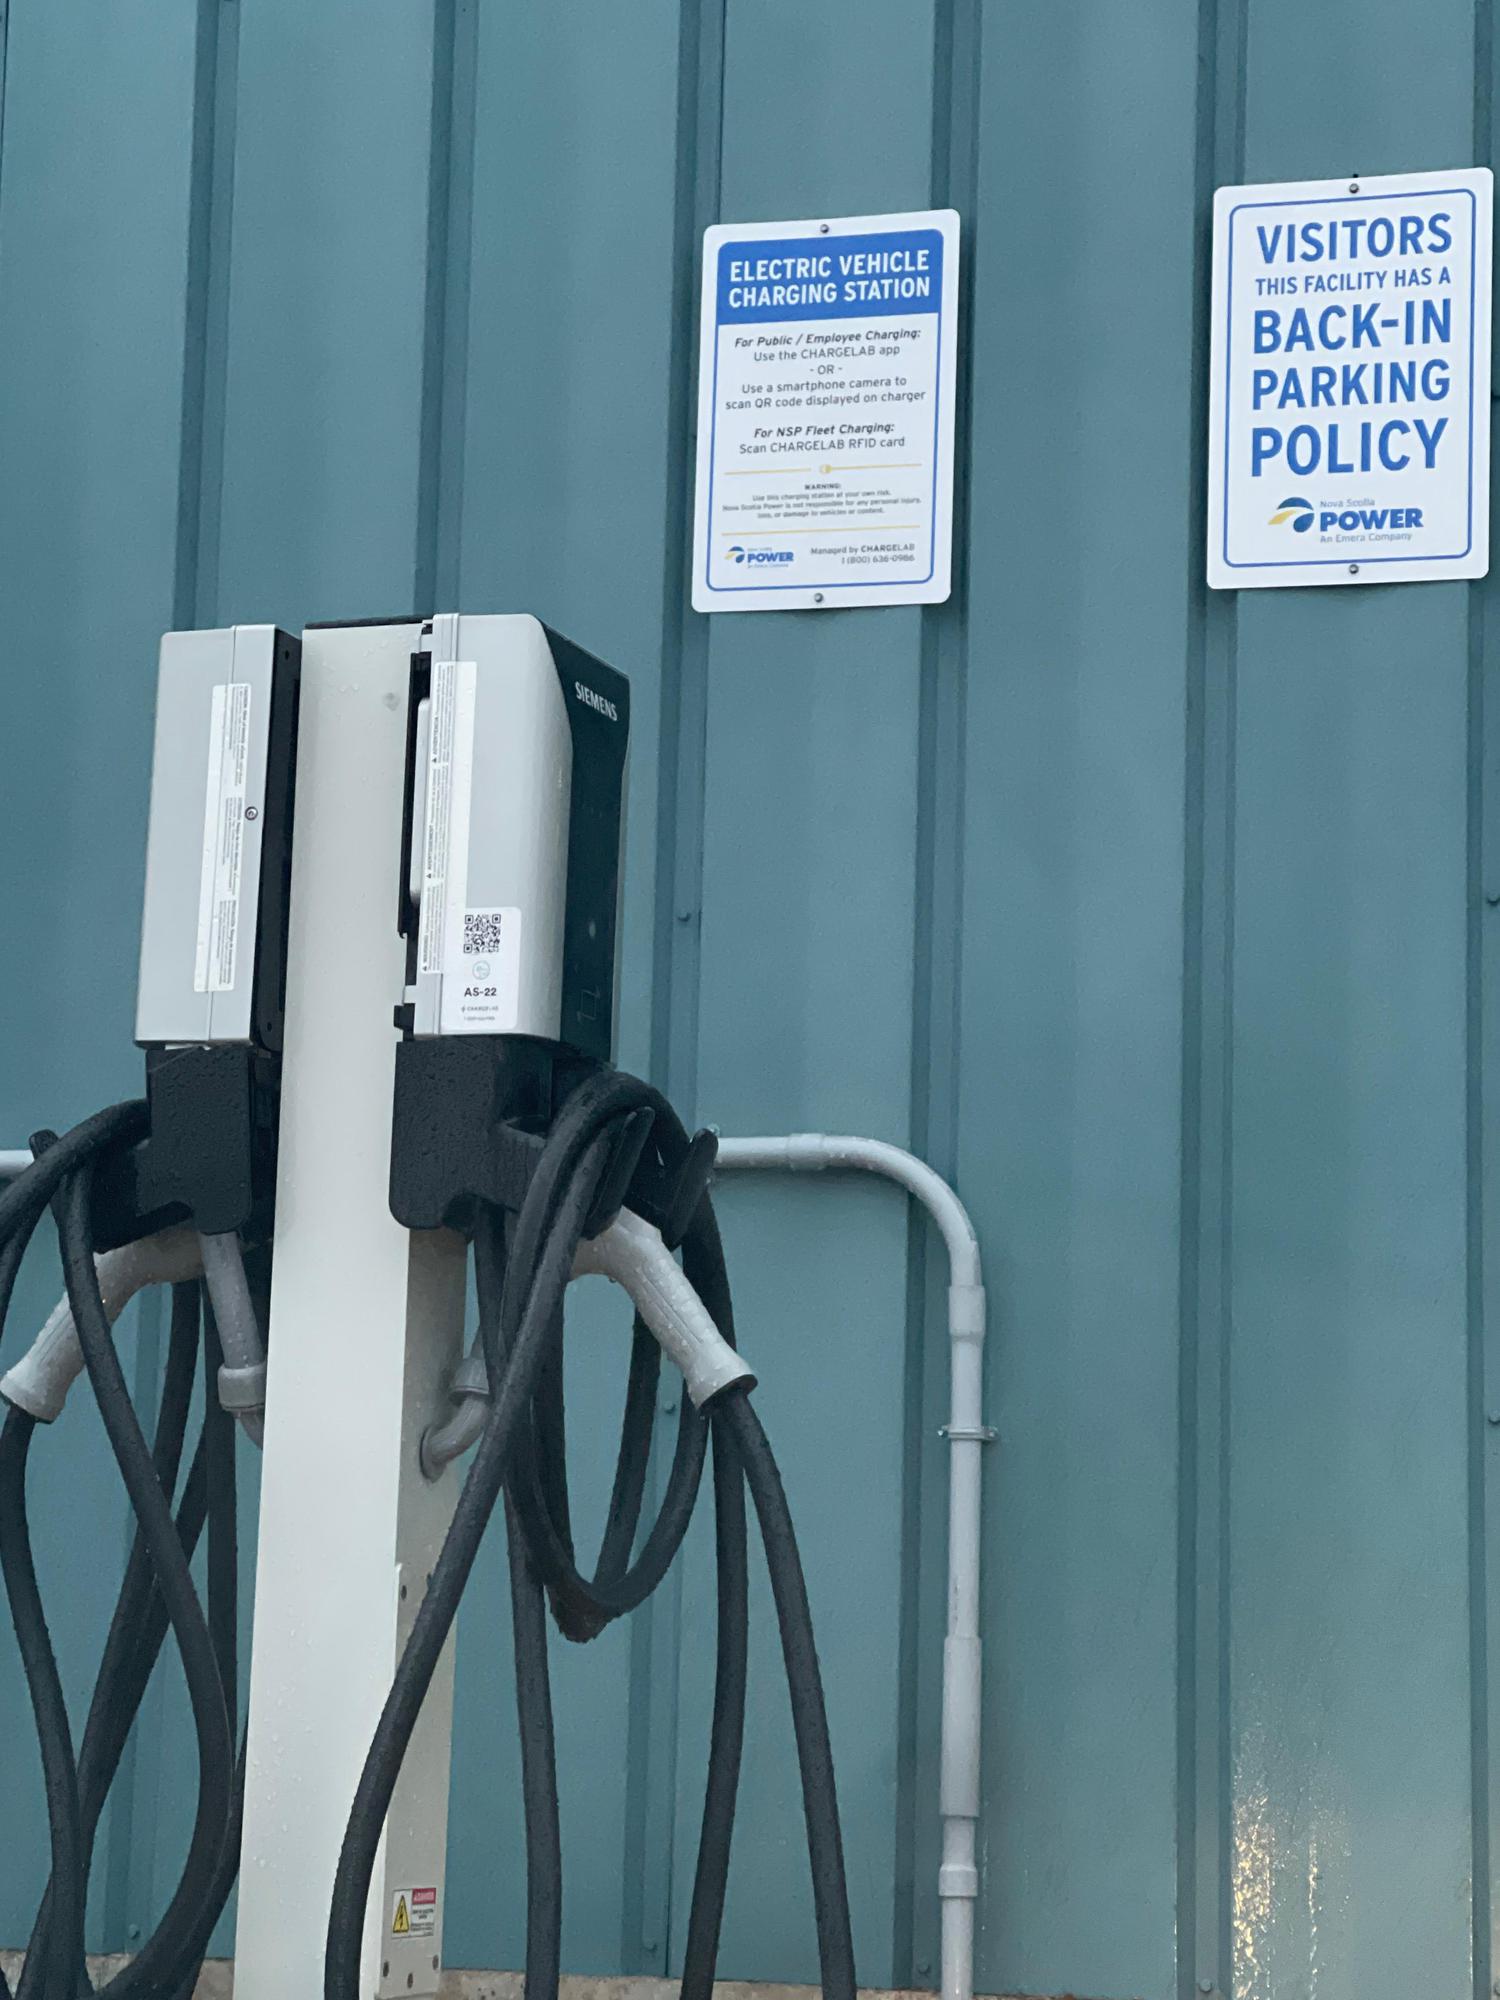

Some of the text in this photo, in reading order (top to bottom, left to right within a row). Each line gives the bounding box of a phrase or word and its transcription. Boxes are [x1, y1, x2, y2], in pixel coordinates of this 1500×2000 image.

[1256, 213, 1453, 264] VISITORS
[730, 250, 929, 282] ELECTRIC VEHICLE
[1256, 267, 1451, 296] THIS FACILITY HAS A
[728, 277, 930, 308] CHARGING STATION
[1253, 298, 1451, 354] BACK-IN
[735, 338, 754, 348] For
[757, 335, 792, 347] Public
[806, 331, 862, 345] Employee
[865, 329, 921, 342] Charging:
[754, 345, 900, 362] Use the CHARGELAB app
[817, 365, 835, 375] OR
[742, 377, 907, 394] Use a smartphone camera to
[1253, 359, 1451, 410] PARKING
[725, 391, 926, 410] scan QR code displayed on charger
[754, 422, 894, 439] For NSP Fleet Charging:
[739, 437, 905, 454] Scan CHARGELAB RFID card
[1251, 417, 1449, 477] POLICY
[780, 494, 810, 502] charging
[805, 500, 844, 508] responsible
[870, 498, 899, 506] personal
[1346, 499, 1375, 507] Scotia
[1320, 508, 1424, 532] POWER
[1336, 534, 1365, 542] Emera
[1369, 533, 1412, 541] Company
[748, 552, 794, 562] POWER
[849, 546, 859, 554] by
[861, 544, 915, 552] CHARGELAB
[847, 556, 870, 564] (800)
[575, 681, 618, 721] SIEMENS
[464, 988, 497, 997] AS-22
